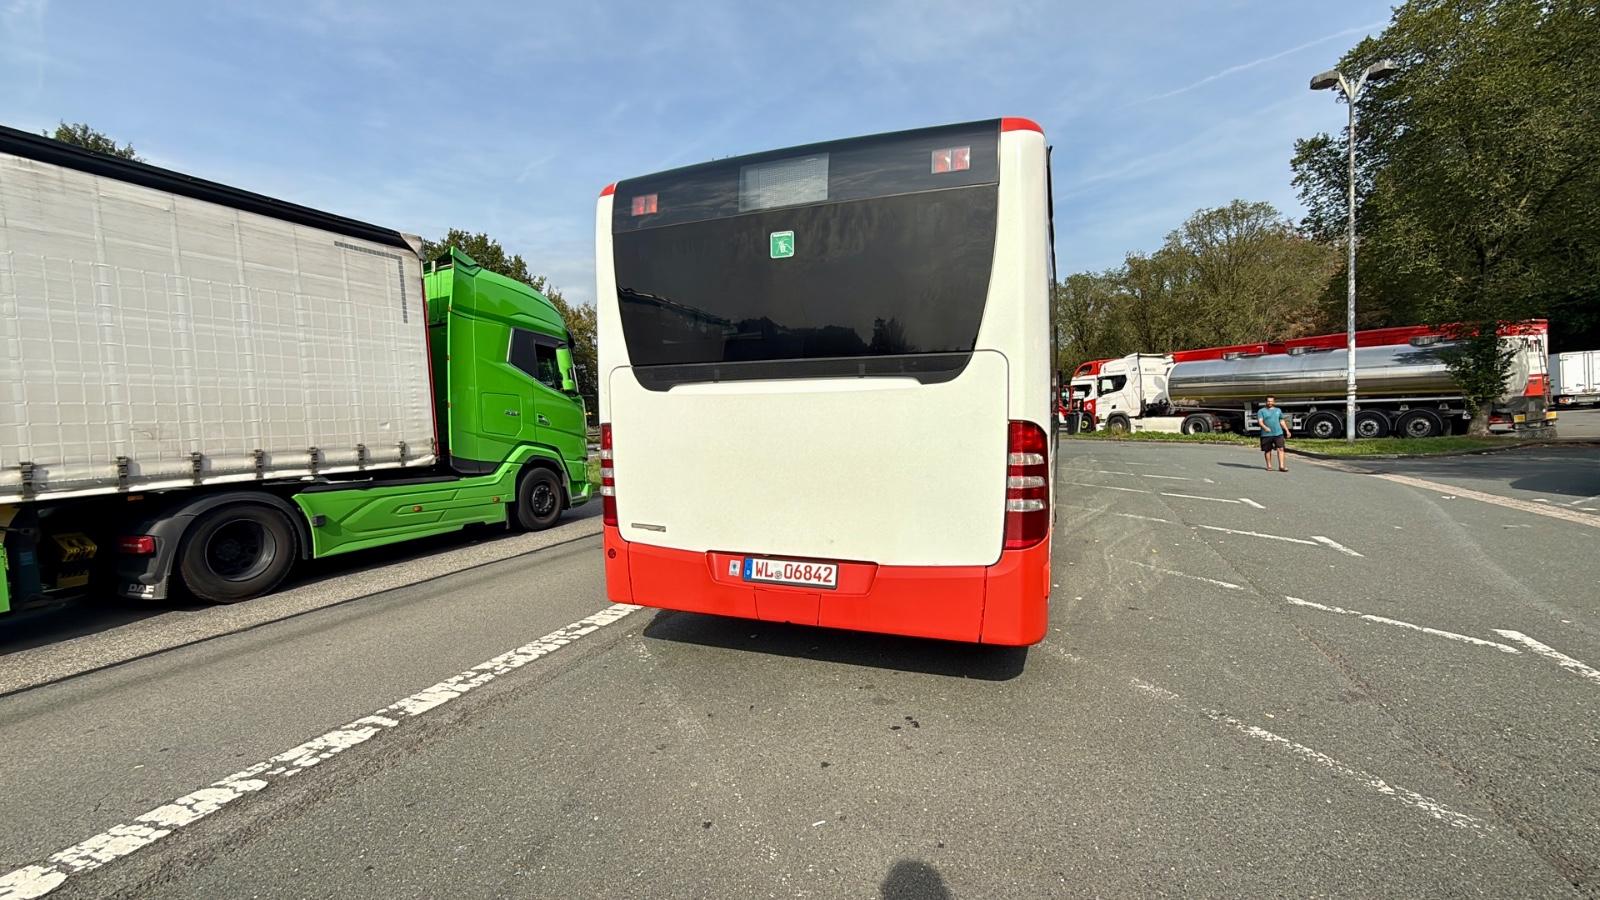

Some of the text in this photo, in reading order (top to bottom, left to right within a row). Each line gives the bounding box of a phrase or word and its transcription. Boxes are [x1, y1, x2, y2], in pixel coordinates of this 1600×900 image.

[755, 561, 833, 583] WL 06842
[128, 583, 155, 594] DAF
